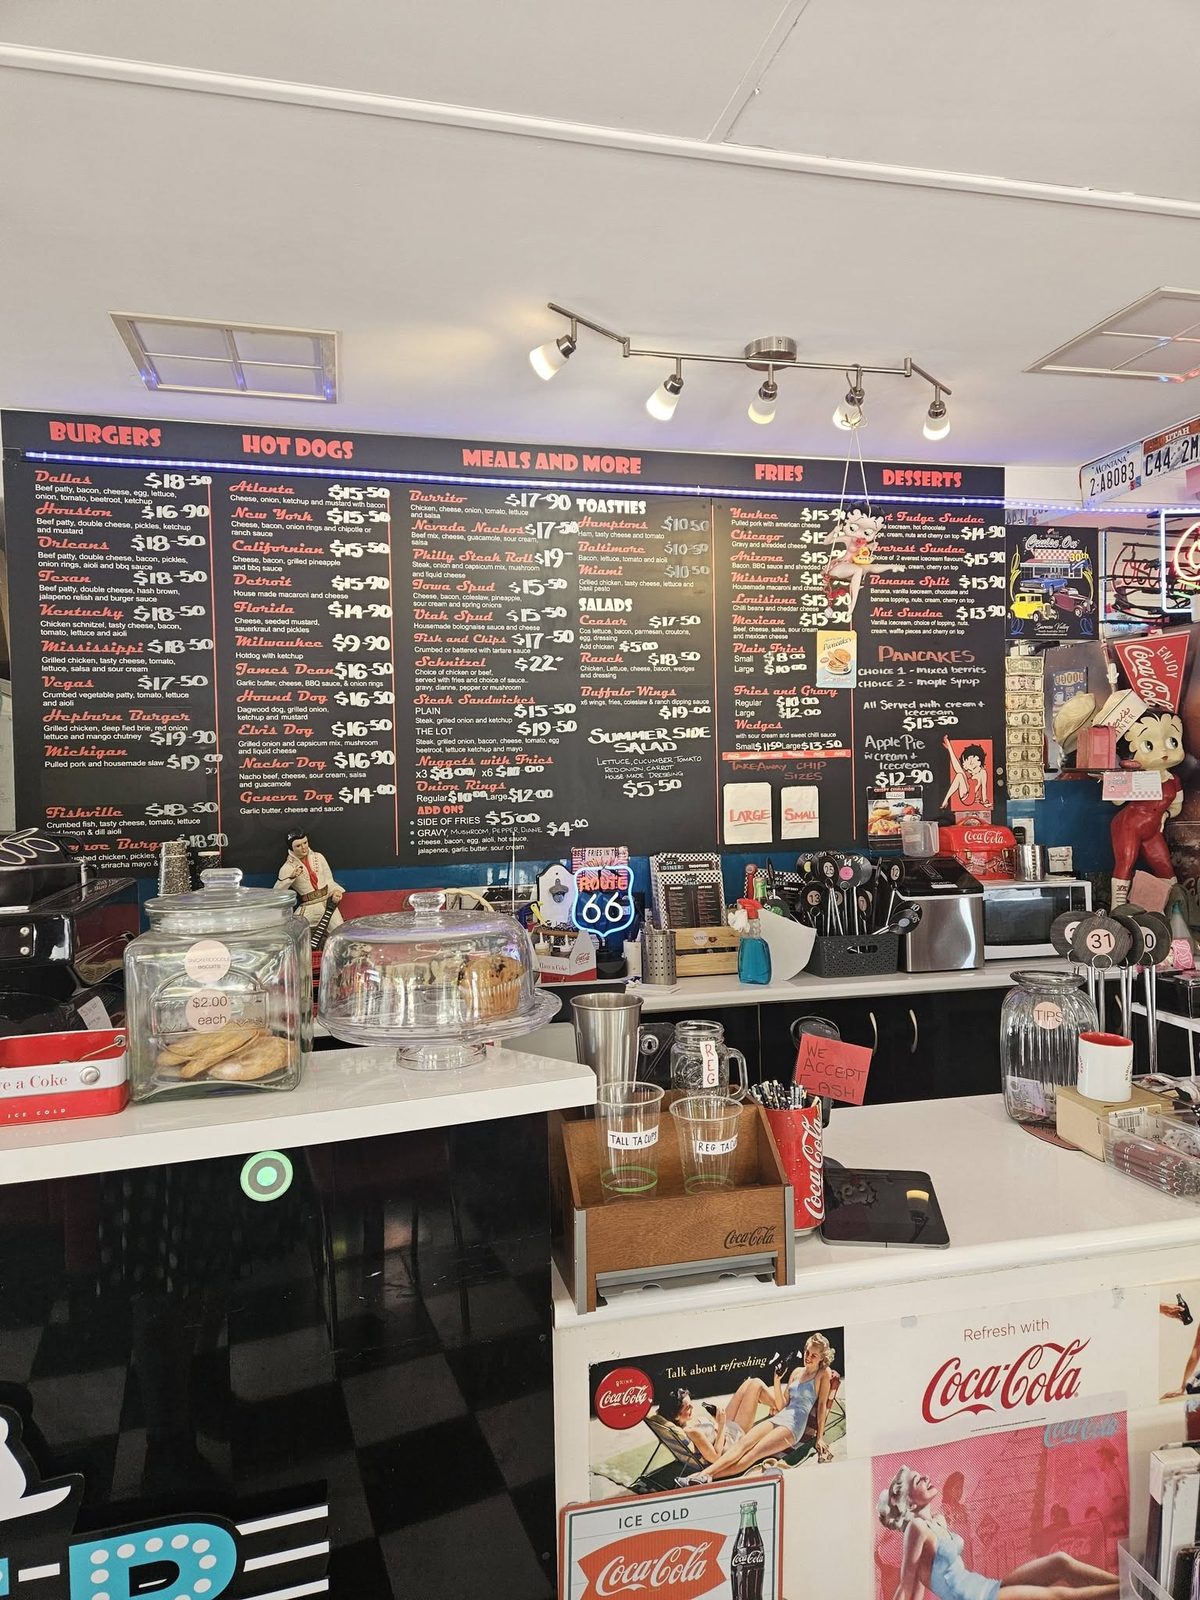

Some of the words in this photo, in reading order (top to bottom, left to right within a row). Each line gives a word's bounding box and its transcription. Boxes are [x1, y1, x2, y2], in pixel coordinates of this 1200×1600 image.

[49, 421, 162, 447] BURGERS
[1165, 426, 1190, 443] UTAH
[242, 435, 290, 454] HOT
[295, 437, 353, 459] DOGS
[462, 449, 530, 470] MEALS
[536, 452, 578, 471] AND
[583, 454, 642, 474] MORE
[1095, 456, 1127, 475] MONTANA
[34, 470, 92, 485] Dallas
[755, 464, 803, 481] FRIES
[883, 469, 962, 488] DESSERTS
[229, 481, 295, 494] Atlanta
[409, 490, 468, 503] Burrito
[36, 503, 112, 517] Houston
[577, 498, 646, 514] TOASTIES
[231, 508, 267, 521] New
[273, 509, 313, 522] York
[730, 508, 778, 520] Yankee
[896, 512, 935, 525] Fudge
[939, 513, 985, 524] Sundae
[412, 520, 466, 533] Nevada
[471, 522, 525, 534] Nachos
[578, 516, 648, 531] Hamptons
[730, 530, 783, 542] Chicago
[37, 536, 110, 551] Orleans
[232, 540, 324, 554] Californian
[578, 541, 646, 554] Baltimore
[412, 549, 454, 563] Philly
[459, 552, 501, 562] Steak
[505, 552, 533, 562] Roll
[731, 551, 783, 562] Arizona
[579, 565, 623, 576] Miami
[38, 571, 91, 584] Texan
[234, 574, 292, 587] Detroit
[731, 572, 789, 583] Missouri
[870, 575, 915, 586] Banana
[919, 575, 950, 587] Split
[412, 580, 451, 591] Iowa
[456, 580, 496, 592] Spud
[579, 598, 632, 612] SALADS
[732, 593, 796, 604] Louisiana
[40, 604, 124, 619] Kentucky
[234, 601, 295, 614] Florida
[871, 607, 895, 618] Nut
[897, 607, 943, 618] Sundae
[414, 609, 448, 622] Utah
[454, 610, 493, 623] Spud
[732, 615, 785, 625] Mexican
[235, 636, 323, 648] Milwaukee
[414, 633, 442, 643] Fish
[474, 633, 507, 644] Chips
[41, 640, 144, 655] Mississippi
[733, 643, 766, 653] Plain
[771, 643, 805, 654] Fries
[878, 646, 976, 662] PANCAKES
[236, 652, 261, 661] Hotdog
[416, 657, 486, 668] Schnitzel
[580, 652, 623, 663] Ranch
[1156, 646, 1178, 678] ENJOY
[235, 663, 289, 676] James
[294, 664, 336, 674] Dean
[858, 668, 895, 676] CHOICE
[951, 666, 986, 674] berries
[42, 676, 94, 690] Vegas
[897, 679, 905, 687] 2
[237, 690, 292, 702] Hound
[298, 691, 328, 704] Dog
[580, 686, 634, 698] Buffalo
[637, 686, 676, 698] Wings
[734, 686, 769, 696] Fries
[773, 687, 796, 695] and
[801, 686, 838, 698] Gravy
[414, 694, 453, 705] Steak
[459, 694, 535, 705] Sandwiches
[43, 709, 122, 724] Hepburn
[129, 709, 190, 724] Burger
[416, 707, 440, 715] PLAIN
[238, 724, 277, 735] Elvis
[283, 724, 314, 737] Dog
[735, 720, 782, 730] Wedges
[588, 728, 671, 744] SUMMER
[672, 727, 711, 739] SIDE
[865, 735, 900, 749] Apple
[904, 737, 925, 749] Pie
[44, 745, 128, 758] Michigan
[614, 742, 678, 754] SALAD
[45, 760, 68, 768] Pulled
[70, 761, 87, 769] pork
[239, 758, 294, 769] Nacho
[297, 757, 327, 770] Dog
[416, 756, 476, 768] Nuggets
[480, 756, 510, 765] with
[516, 754, 554, 765] Fries
[416, 781, 459, 791] Onion
[466, 781, 507, 791] Rings
[240, 790, 298, 801] Geneva
[304, 790, 334, 801] Dog
[46, 806, 124, 818] Fishville
[417, 806, 441, 814] ADD
[444, 806, 464, 814] ONS
[730, 809, 771, 821] LARGE
[785, 809, 818, 820] SMALL
[417, 818, 438, 826] SIDE
[454, 816, 480, 824] FRIES
[579, 876, 628, 892] ROUTE
[583, 892, 623, 923] 66
[1091, 933, 1112, 949] 31
[193, 996, 227, 1008] $2.00
[198, 1014, 226, 1025] each
[1034, 1008, 1063, 1023] TIPS
[807, 1040, 828, 1058] WE
[704, 1043, 715, 1085] REG
[804, 1057, 867, 1081] ACCEPT
[16, 1081, 24, 1089] a
[30, 1074, 68, 1088] Coke
[610, 1134, 629, 1146] TALL
[698, 1142, 716, 1152] REG
[724, 1225, 776, 1249] Coca-Cola
[963, 1324, 1016, 1342] Refresh
[1020, 1318, 1050, 1333] with
[665, 1367, 687, 1379] Talk
[690, 1364, 717, 1376] about
[720, 1356, 767, 1372] refreshing
[921, 1337, 1092, 1424] Coca-Cola
[600, 1385, 649, 1409] Coca-Cola
[618, 1515, 643, 1529] ICE
[651, 1508, 689, 1523] COLD
[731, 1549, 764, 1567] Coca-Cola
[596, 1540, 713, 1596] Coca-Cola
